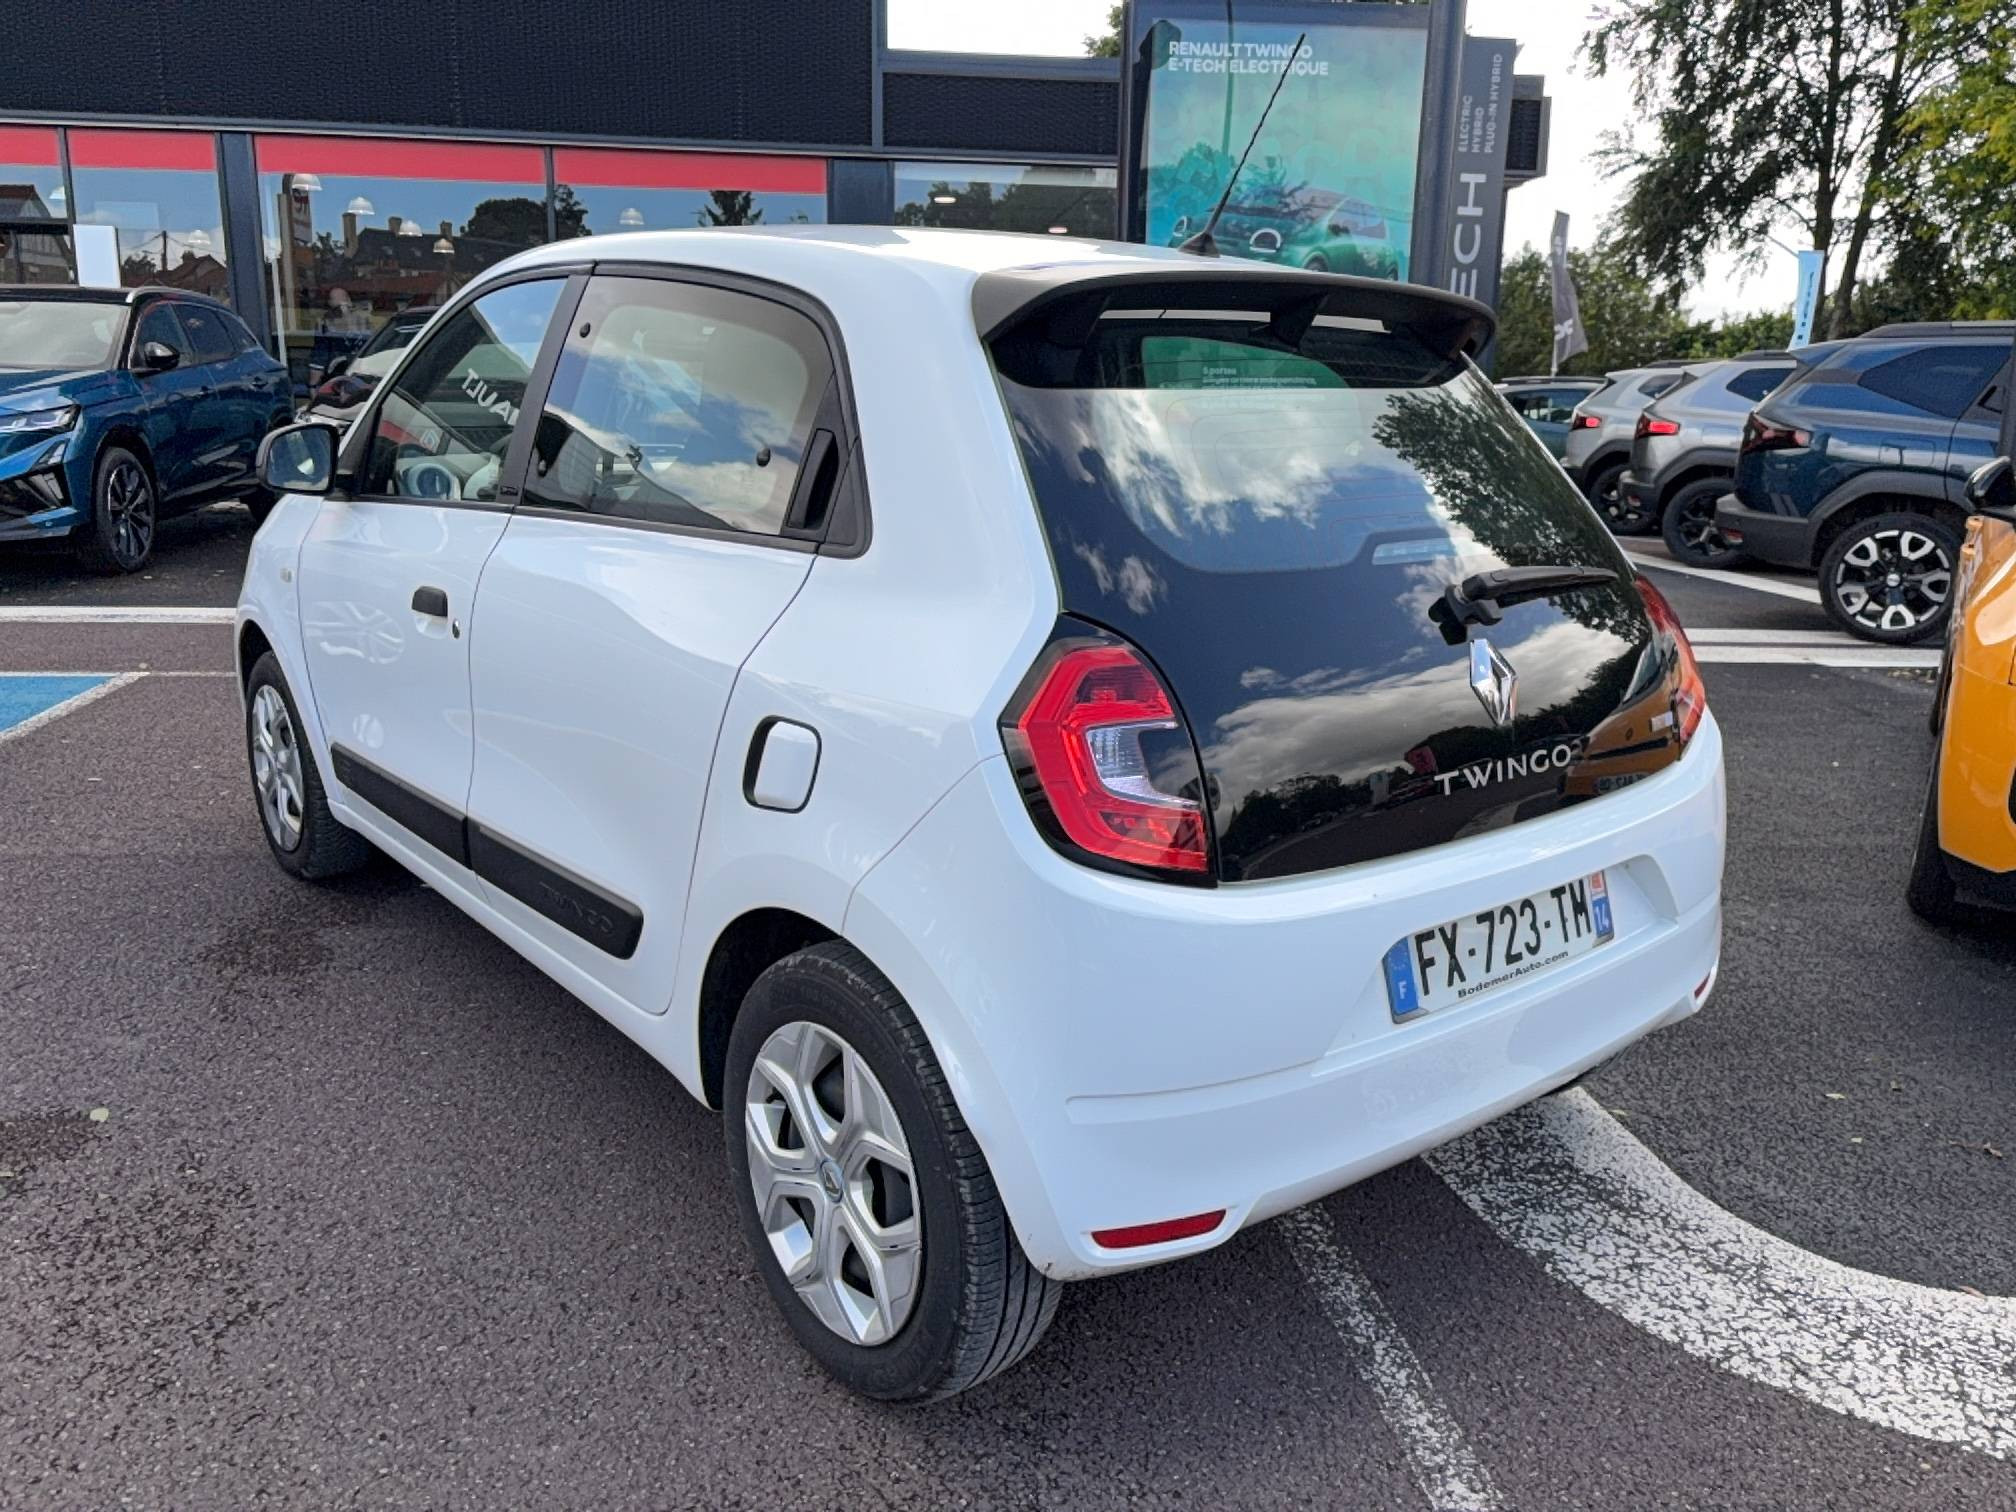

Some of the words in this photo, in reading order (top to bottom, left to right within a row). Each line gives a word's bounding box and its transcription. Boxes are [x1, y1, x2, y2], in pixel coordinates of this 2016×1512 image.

[1167, 57, 1227, 73] E-TECH
[1229, 60, 1329, 77] ELECTRIQUE
[1168, 41, 1242, 57] RENAULT
[1244, 43, 1313, 59] TWINGO
[1489, 53, 1503, 101] HYBRID
[1458, 95, 1473, 153] ELECTRIC
[1471, 106, 1485, 153] HYBRID
[1484, 103, 1499, 153] PLUG-IN
[1434, 744, 1572, 796] TWINGO
[1414, 878, 1592, 996] FX-723-TM
[1595, 904, 1610, 932] 14
[1457, 950, 1569, 998] BodemerAuto.com
